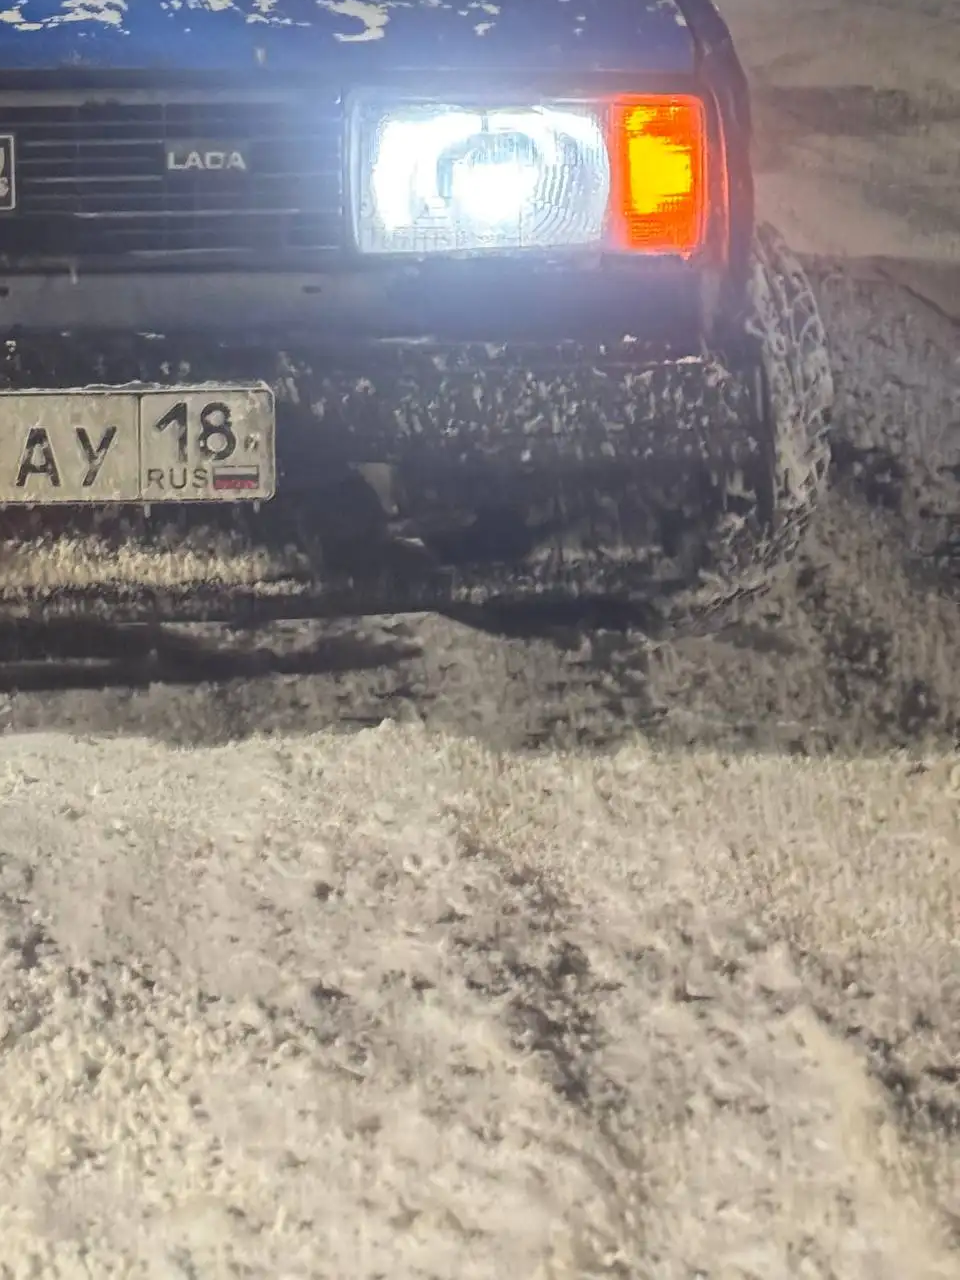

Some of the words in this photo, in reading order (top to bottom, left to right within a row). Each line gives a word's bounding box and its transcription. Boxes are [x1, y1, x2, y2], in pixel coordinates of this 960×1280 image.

[166, 151, 247, 171] LADA
[155, 401, 237, 463] 18
[146, 468, 209, 490] RUS
